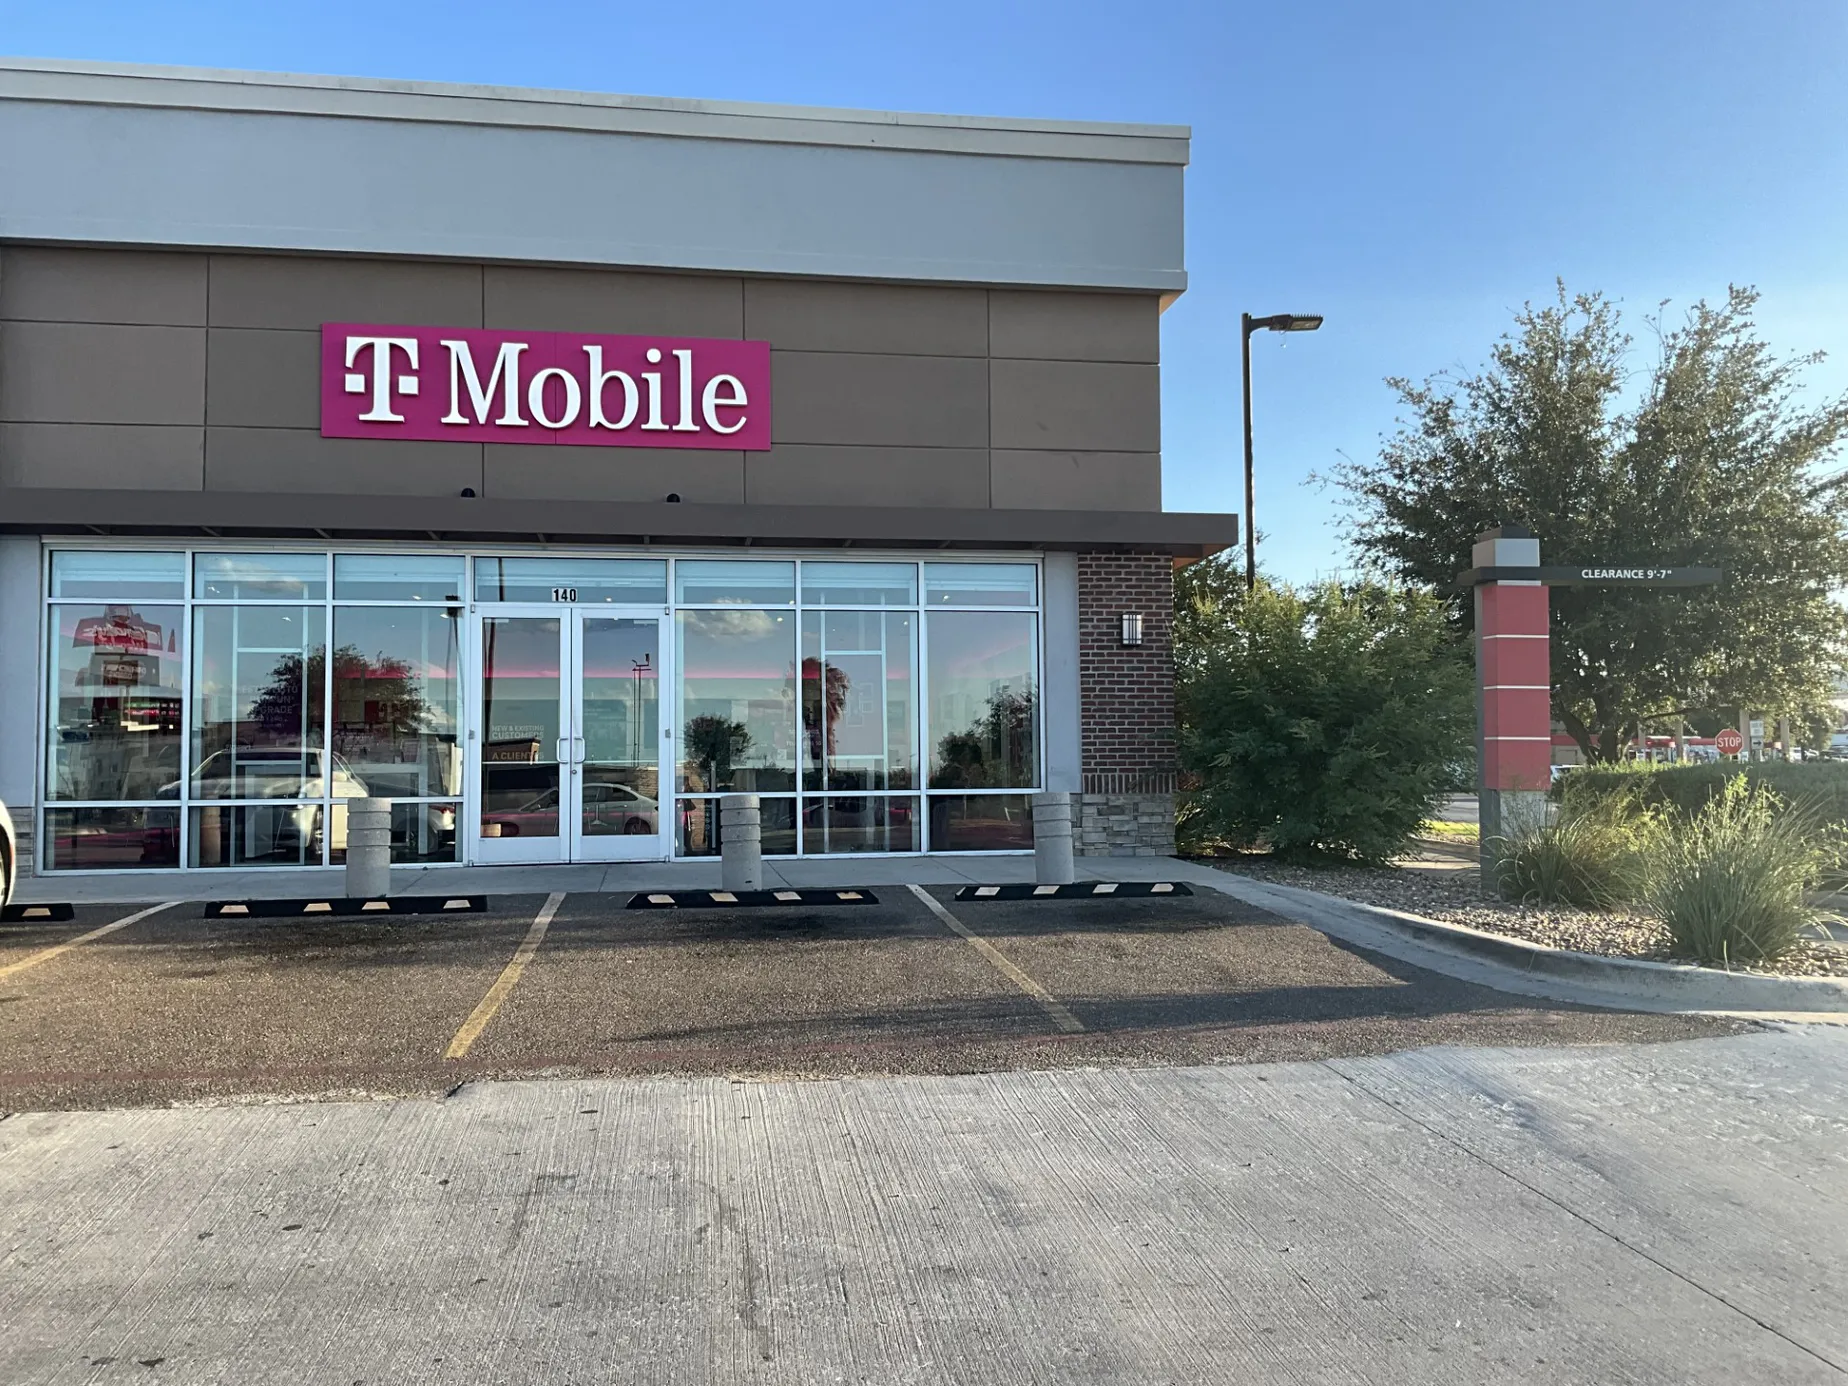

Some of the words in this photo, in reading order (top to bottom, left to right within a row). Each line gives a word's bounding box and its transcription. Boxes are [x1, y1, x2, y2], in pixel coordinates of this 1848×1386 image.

[440, 339, 748, 434] Mobile
[1581, 569, 1644, 579] CLEARANCE
[1646, 569, 1672, 579] 9'-7"
[553, 588, 577, 602] 140
[492, 731, 544, 740] CUSTOMERS
[1717, 736, 1742, 748] STOP
[500, 751, 545, 760] CLIENTS
